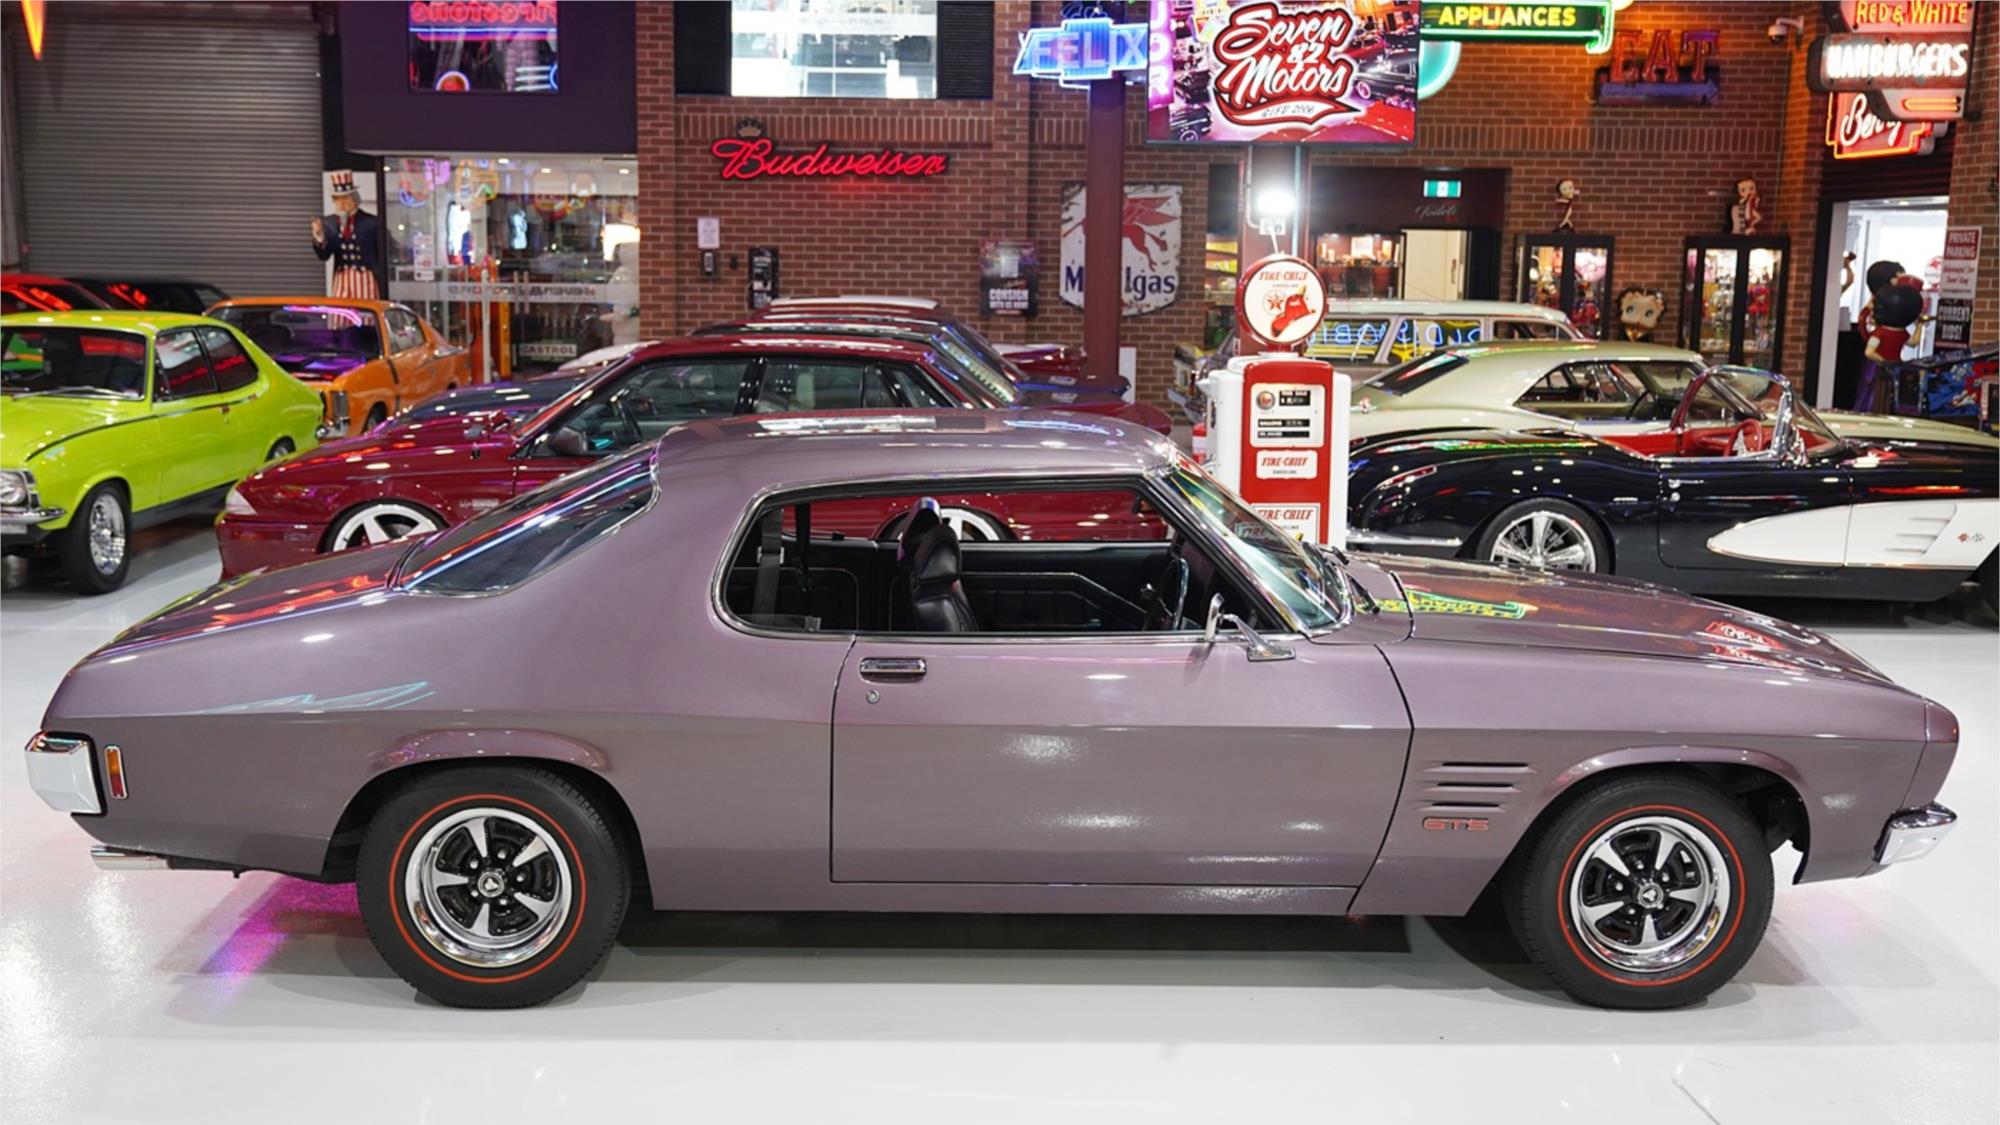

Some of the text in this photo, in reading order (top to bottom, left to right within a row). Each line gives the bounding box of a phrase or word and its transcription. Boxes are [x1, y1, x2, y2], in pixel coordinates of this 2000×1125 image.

[1438, 7, 1577, 27] APPLIANCES
[1857, 1, 1968, 26] RED & WHITE
[1031, 31, 1147, 71] FELIX
[1220, 8, 1348, 61] Seven
[1610, 30, 1718, 82] EAT
[1827, 43, 1969, 78] HAMBURGERS
[1221, 54, 1349, 106] Motors
[712, 139, 947, 179] Budweiser
[1065, 266, 1175, 301] Mlgas
[1422, 816, 1489, 831] GTS
